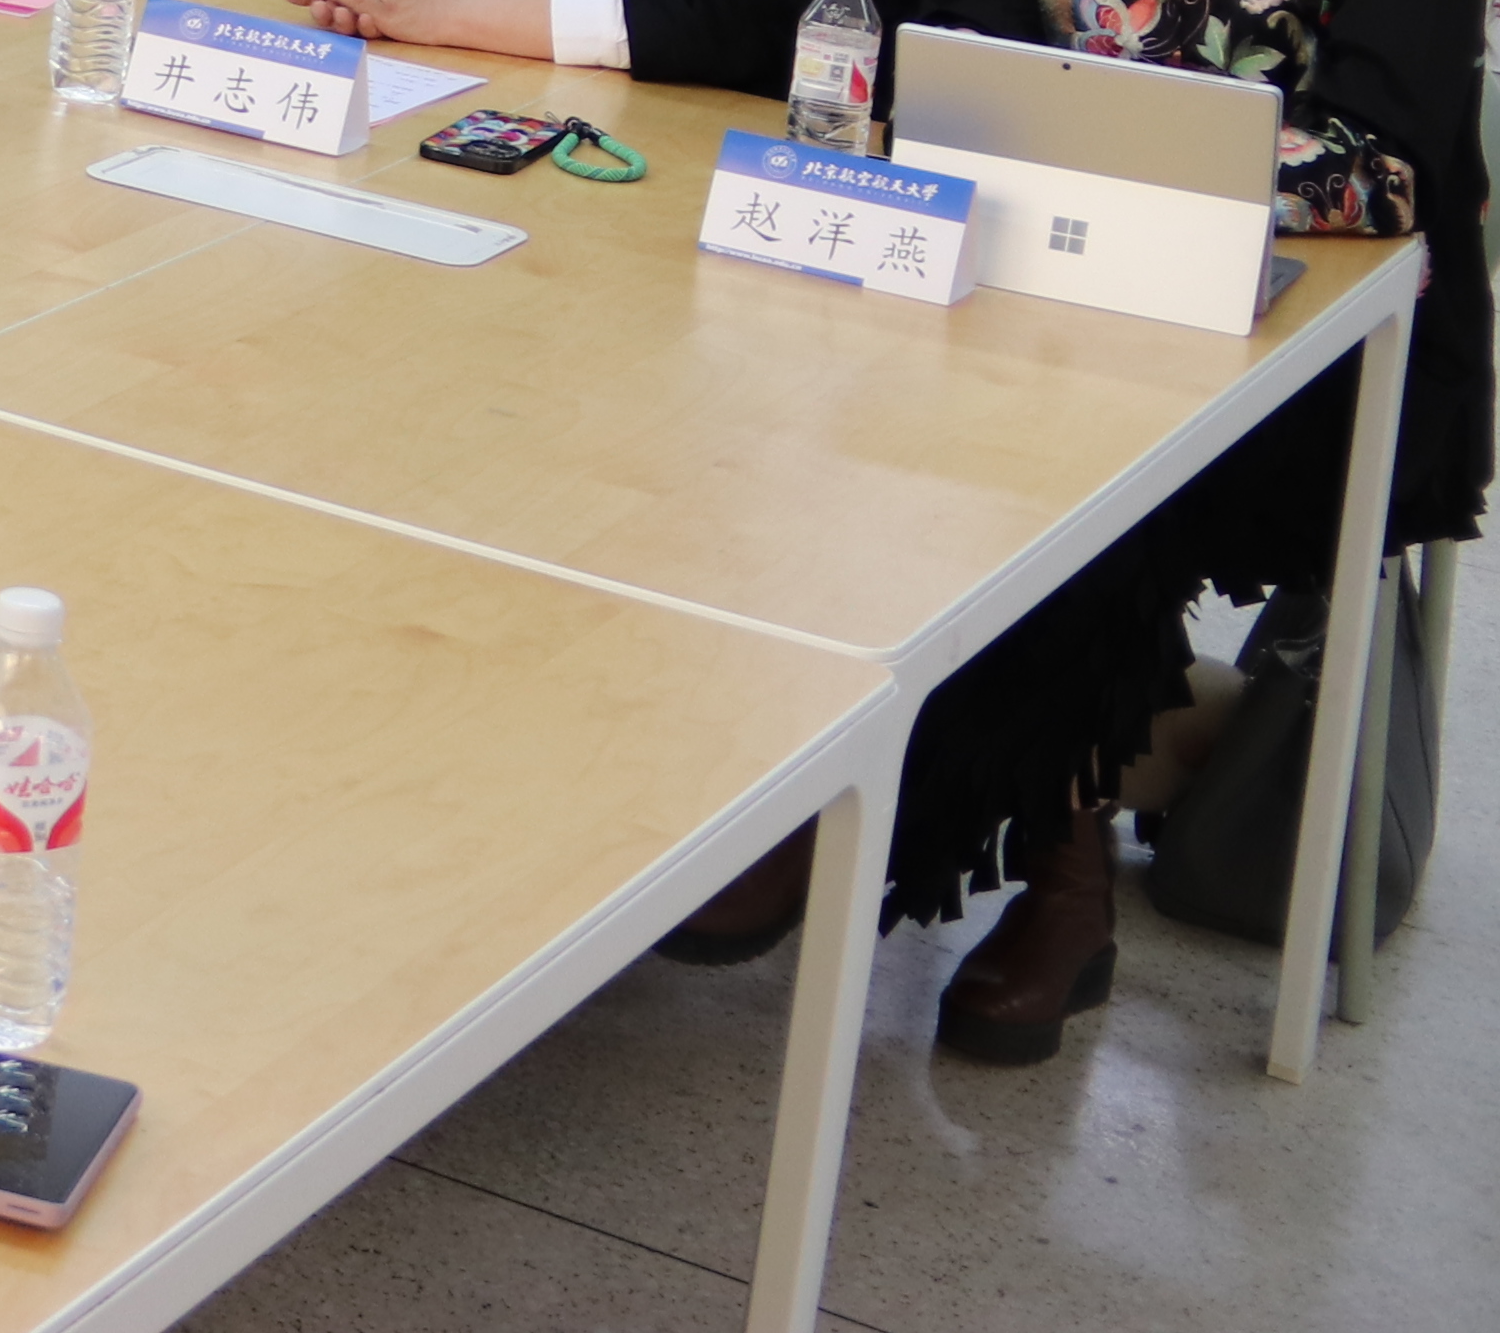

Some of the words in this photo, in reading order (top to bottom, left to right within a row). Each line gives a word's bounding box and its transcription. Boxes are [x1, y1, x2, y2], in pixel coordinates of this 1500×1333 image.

[154, 54, 319, 130] 井志伟
[730, 191, 928, 279] 赵洋燕
[4, 773, 78, 798] 娃哈哈
